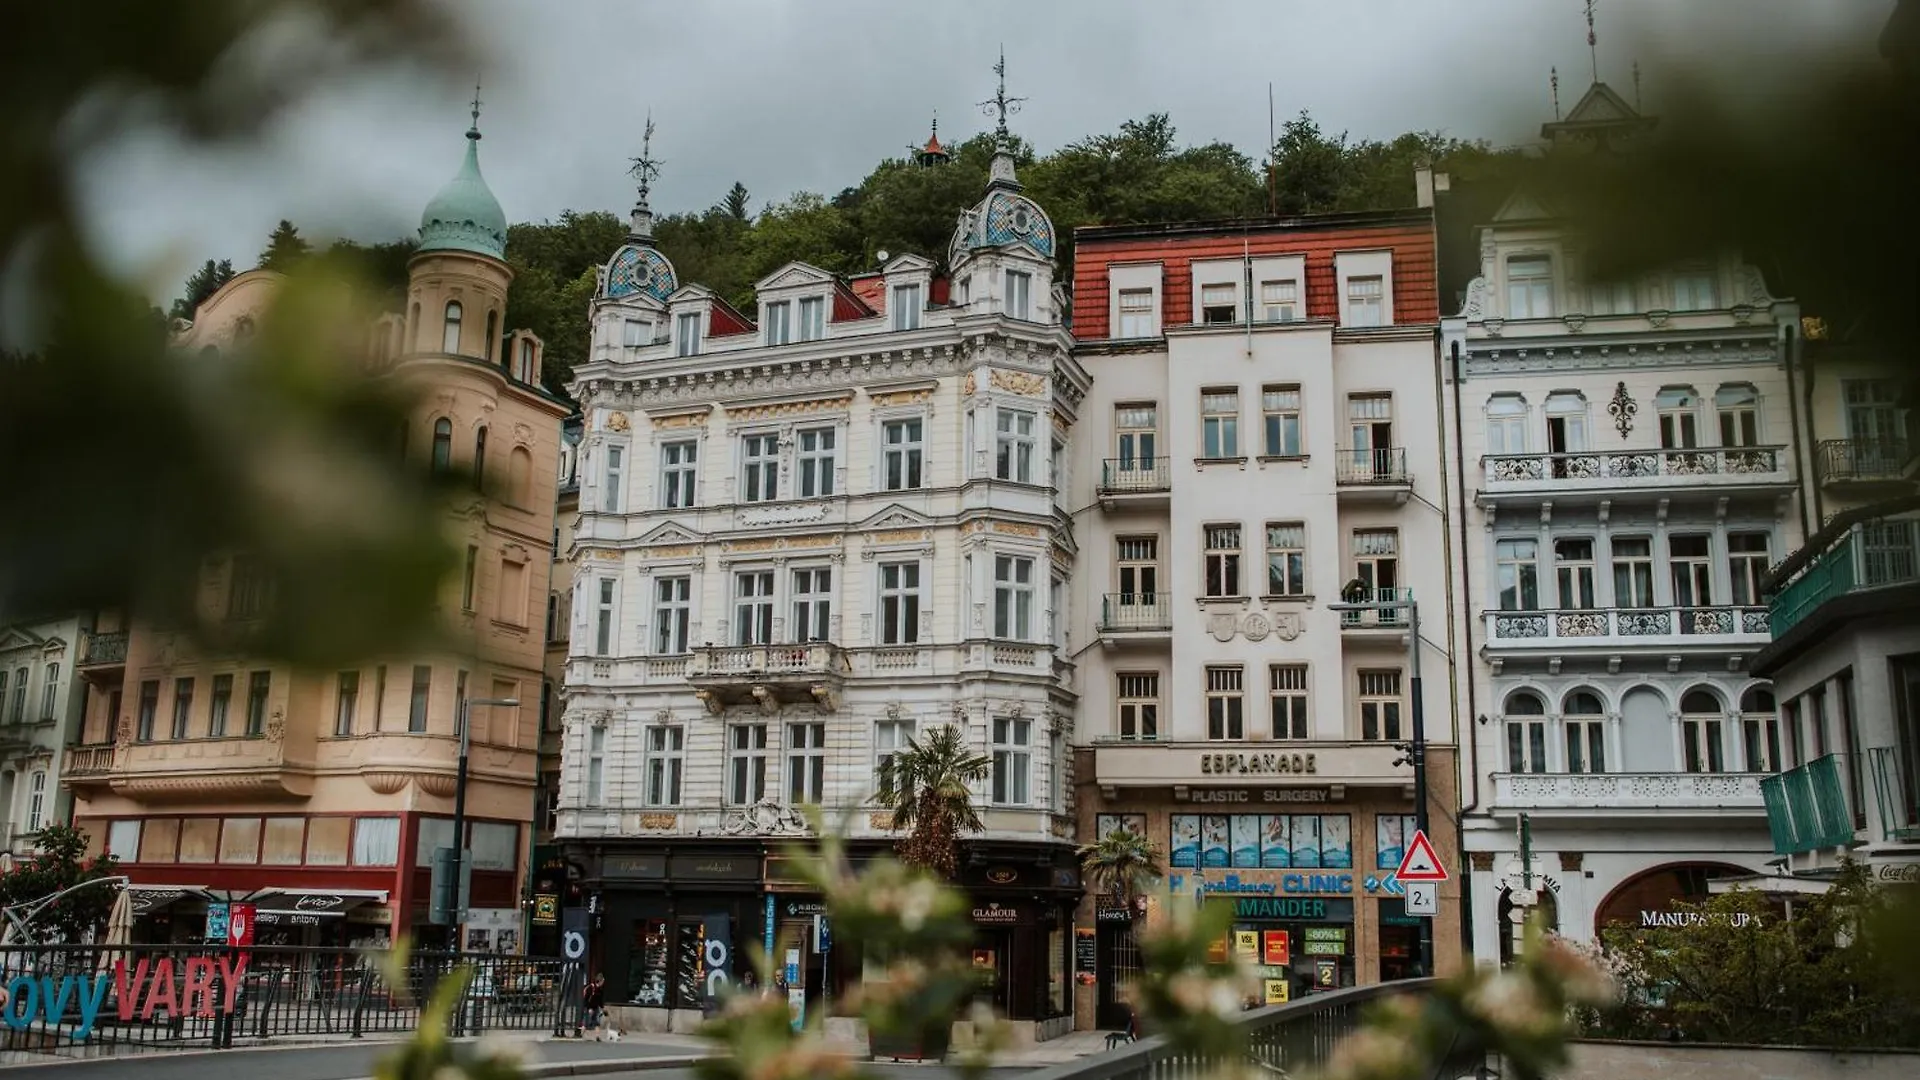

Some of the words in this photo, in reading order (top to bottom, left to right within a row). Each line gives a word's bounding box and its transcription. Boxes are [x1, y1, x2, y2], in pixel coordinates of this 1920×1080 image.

[1201, 753, 1316, 774] ESPLANADE
[1192, 790, 1249, 802] PLASTIC
[1263, 790, 1328, 802] SURGERY
[1282, 874, 1353, 894] CLINIC
[1413, 890, 1422, 906] 2
[972, 908, 1018, 918] GLAMOUR
[1640, 910, 1763, 928] MANUFAURA
[115, 954, 249, 1021] VARY
